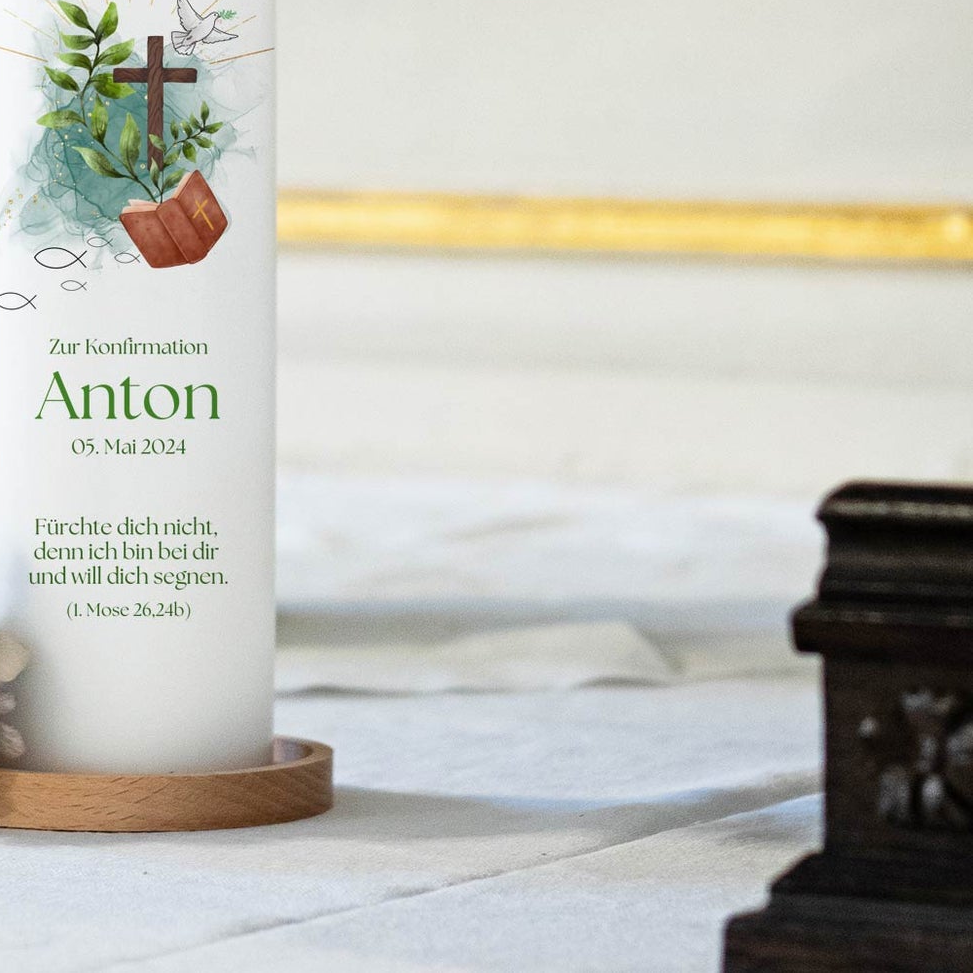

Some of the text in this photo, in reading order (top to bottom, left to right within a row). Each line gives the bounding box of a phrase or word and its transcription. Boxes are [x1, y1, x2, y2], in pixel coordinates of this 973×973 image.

[49, 337, 208, 355] Zur Konfirmation
[34, 370, 220, 420] Anton
[71, 438, 186, 457] 05. Mai 2024
[35, 516, 218, 537] Fürchte dich nicht,
[33, 541, 219, 560] denn ich bin bei dir
[29, 566, 228, 590] und will dich segnen.
[86, 603, 129, 617] Mose
[133, 602, 191, 619] 26,24b)
